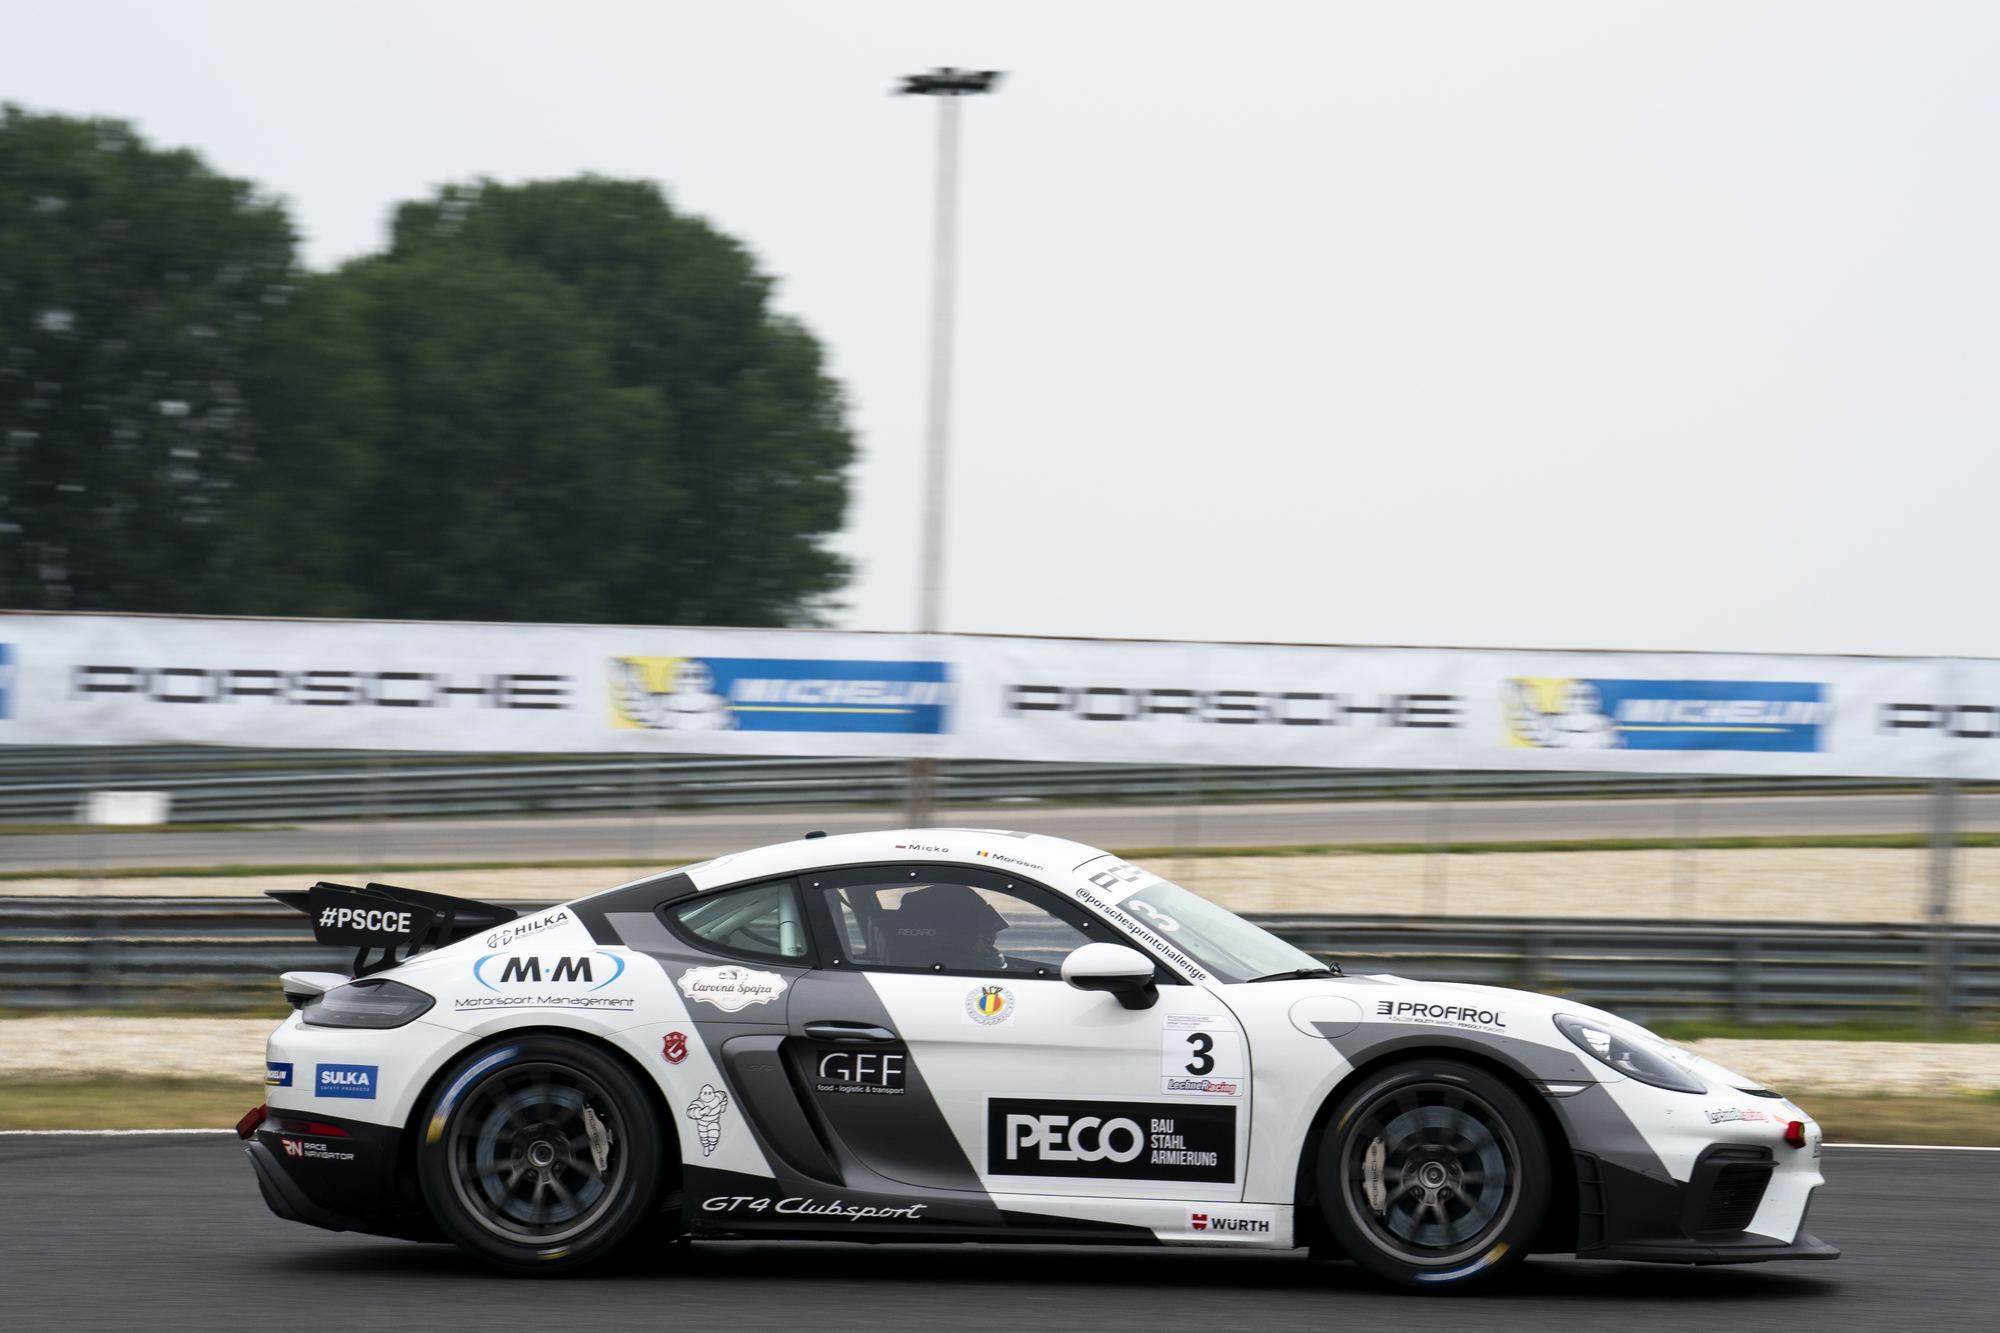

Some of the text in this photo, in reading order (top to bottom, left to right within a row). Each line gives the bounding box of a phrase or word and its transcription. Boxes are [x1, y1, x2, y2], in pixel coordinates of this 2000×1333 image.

[70, 664, 573, 710] PORSCHE
[730, 678, 956, 706] MICHELIN
[1005, 684, 1464, 728] PORSCHE
[908, 844, 949, 853] Micko
[318, 906, 412, 934] #PSCCE
[515, 912, 568, 935] HILKA
[1075, 887, 1207, 982] @porschesprintchallenge
[537, 995, 635, 1007] Management
[1397, 1002, 1506, 1027] PROFIROL
[1184, 1032, 1215, 1076] 3
[321, 1070, 370, 1085] SULKA
[820, 1052, 904, 1086] GFF
[839, 1085, 864, 1094] logistic
[872, 1087, 904, 1095] transport
[1151, 1118, 1174, 1134] BAU
[304, 1142, 327, 1151] RACE
[1006, 1113, 1145, 1163] PECO
[1151, 1134, 1187, 1150] STAHL
[304, 1151, 354, 1160] NAVIGATOR
[1150, 1150, 1217, 1167] ARMIERUNG
[774, 1197, 928, 1221] Clubsport
[1211, 1216, 1270, 1232] WÜRTH
